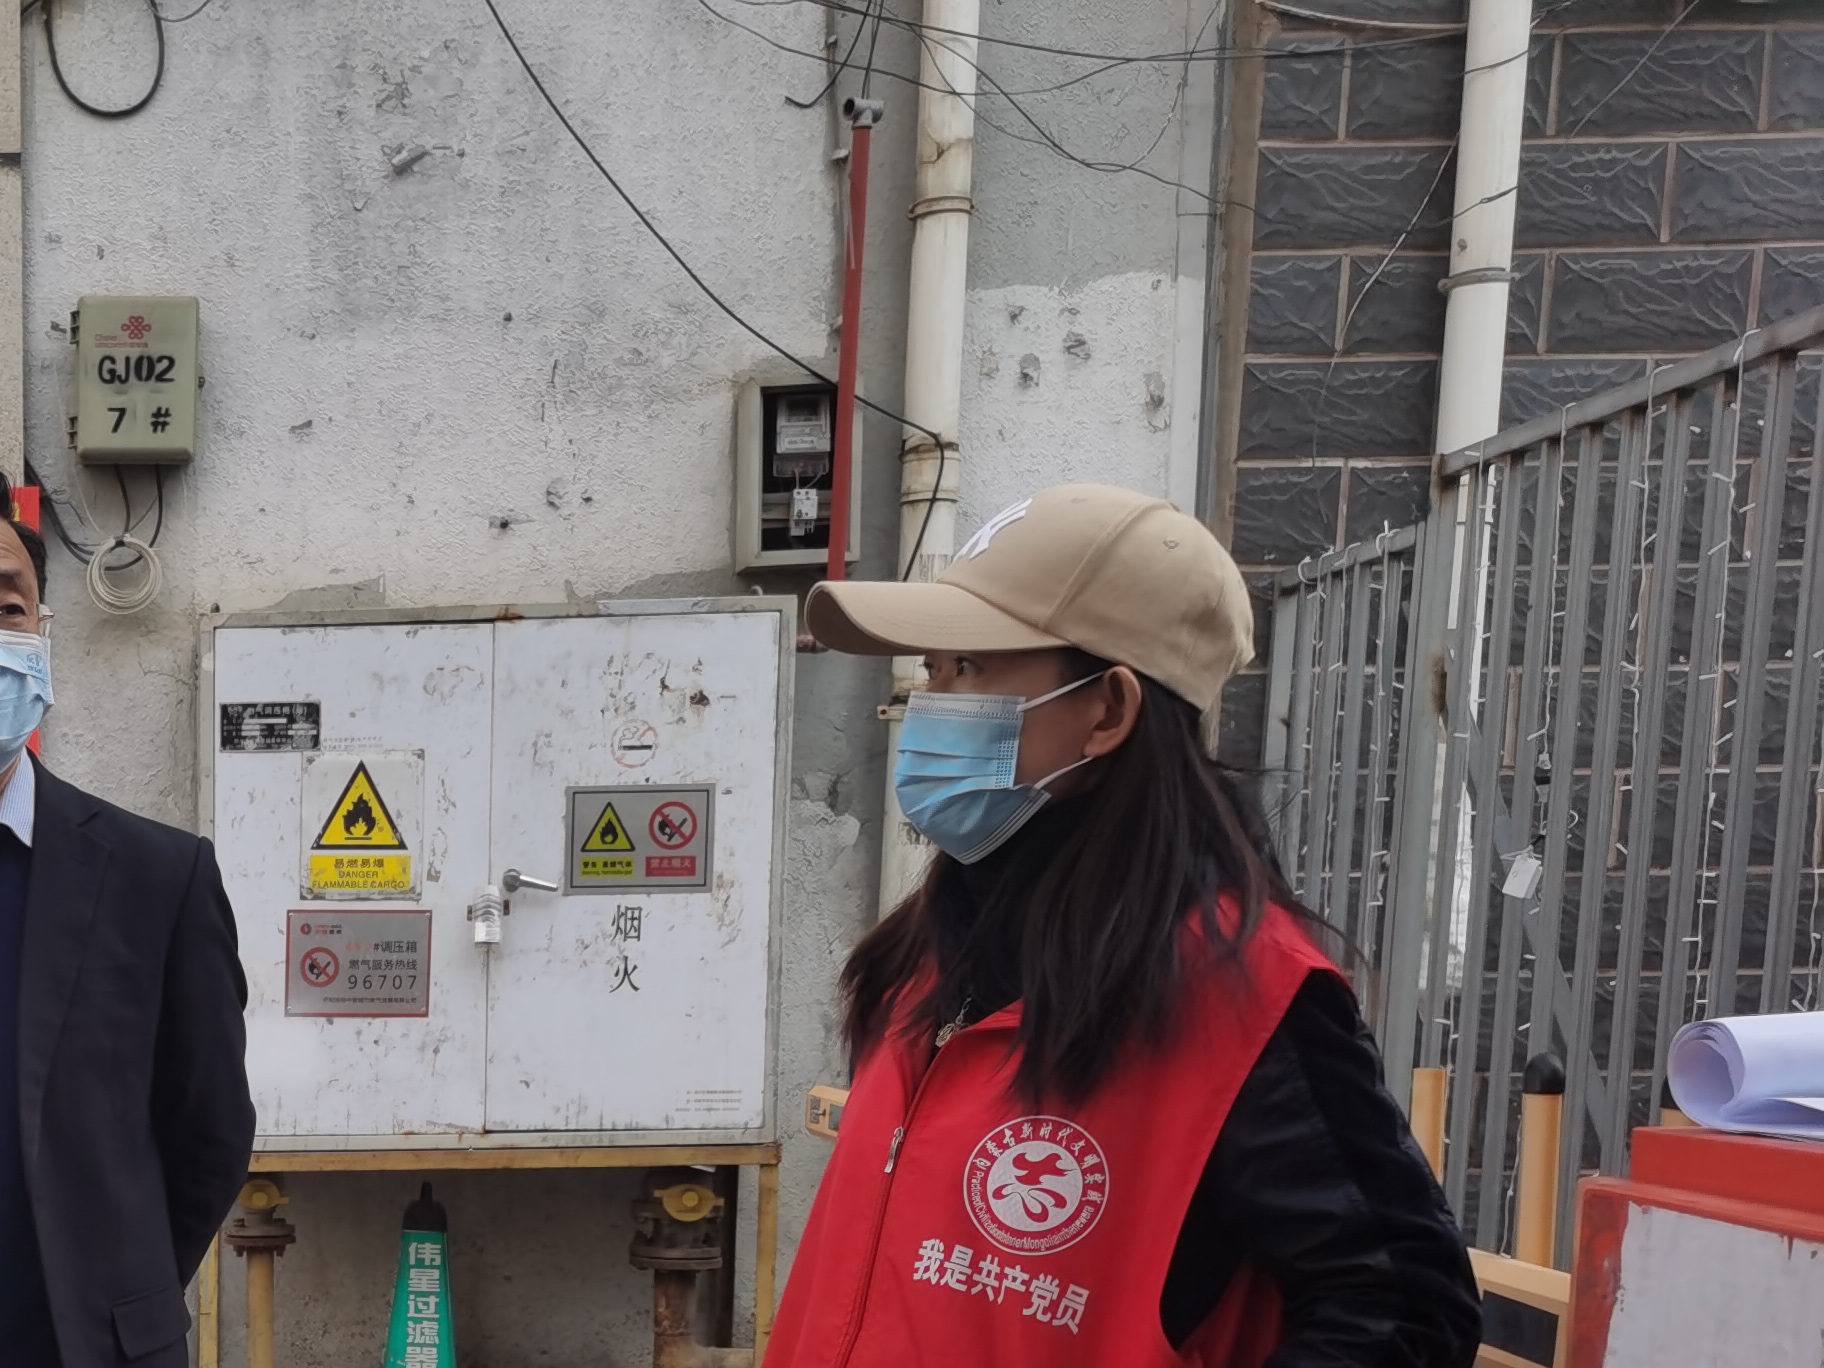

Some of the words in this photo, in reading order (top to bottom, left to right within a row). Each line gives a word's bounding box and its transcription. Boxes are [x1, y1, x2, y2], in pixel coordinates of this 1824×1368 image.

[98, 355, 176, 384] GJ02
[107, 407, 127, 433] 7
[334, 858, 384, 868] 易燃易爆
[338, 870, 378, 878] DANGER
[312, 880, 368, 889] FLAMMABLE
[370, 880, 405, 889] CARGO
[348, 959, 418, 971] 燃气服务热线
[348, 974, 417, 990] 96707
[913, 1238, 1090, 1335] 我是共产党员
